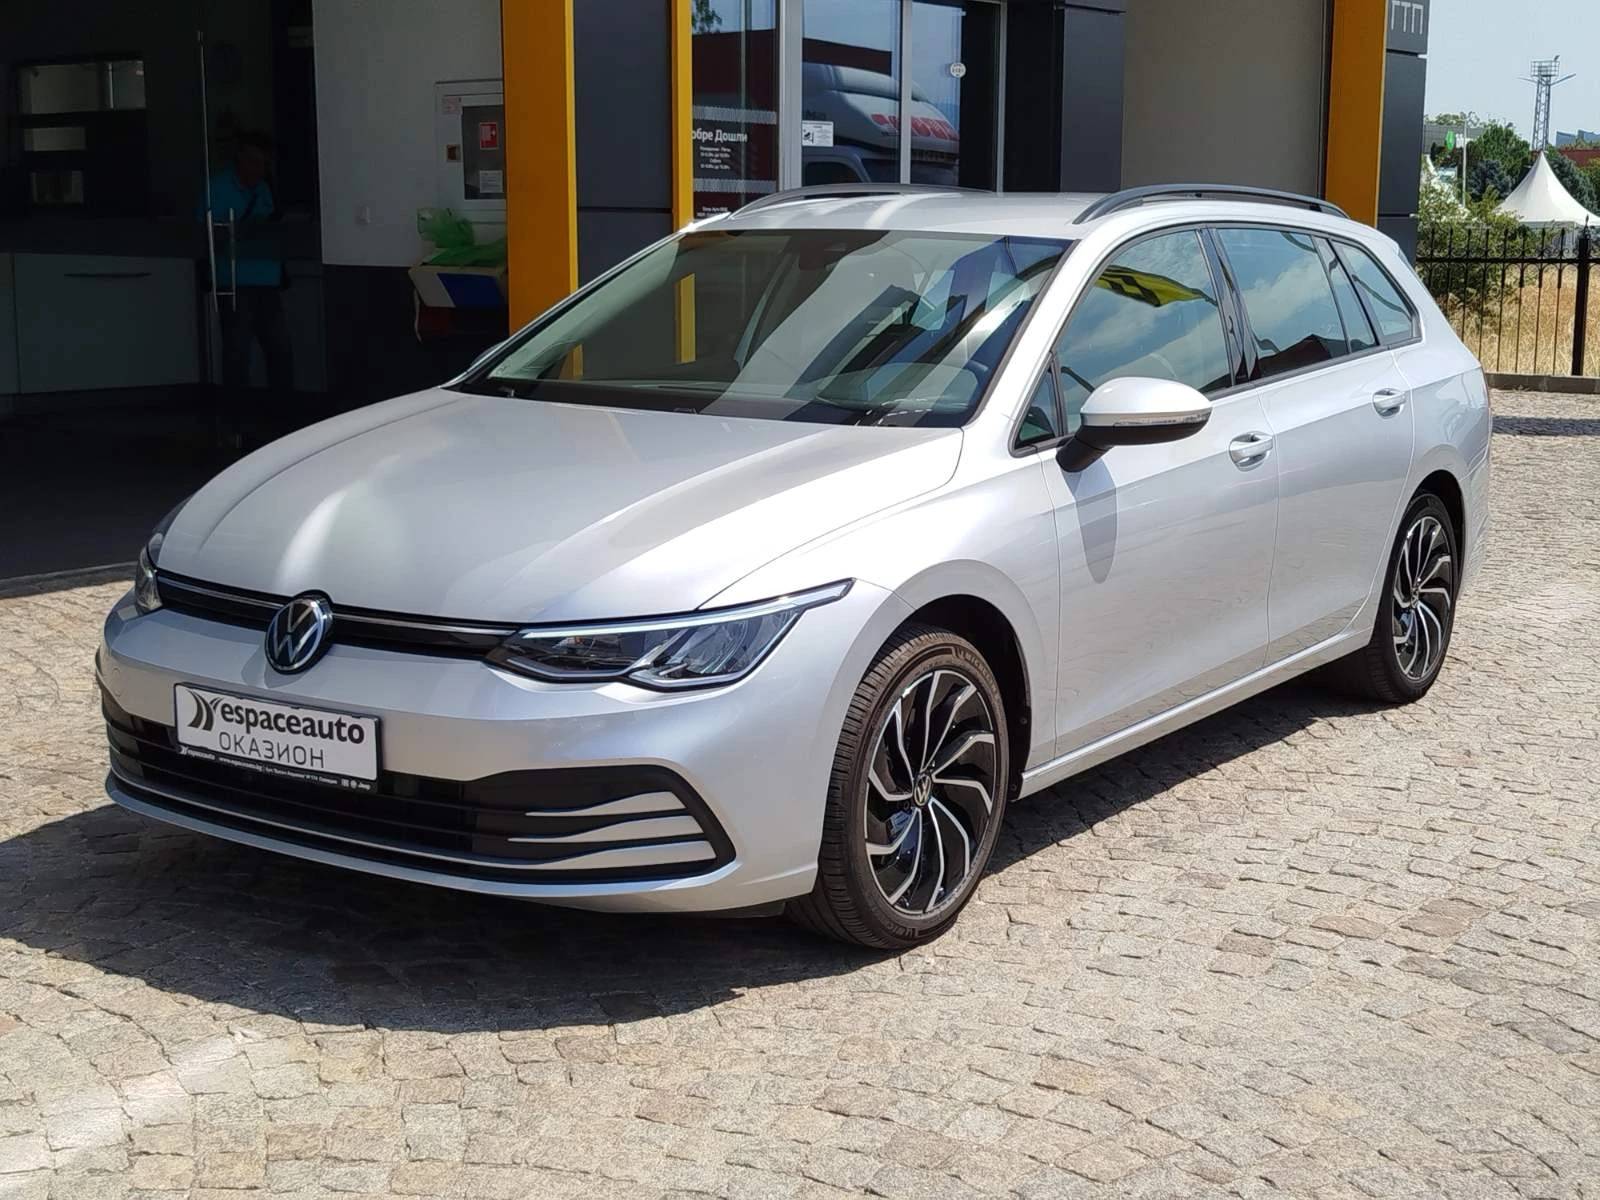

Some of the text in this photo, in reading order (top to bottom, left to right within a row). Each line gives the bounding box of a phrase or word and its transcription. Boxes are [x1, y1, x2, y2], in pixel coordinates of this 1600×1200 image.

[1391, 0, 1424, 34] ГТП
[691, 128, 748, 143] обре Дошли
[220, 703, 365, 744] espaceauto
[219, 731, 324, 769] ОКАЗИОН
